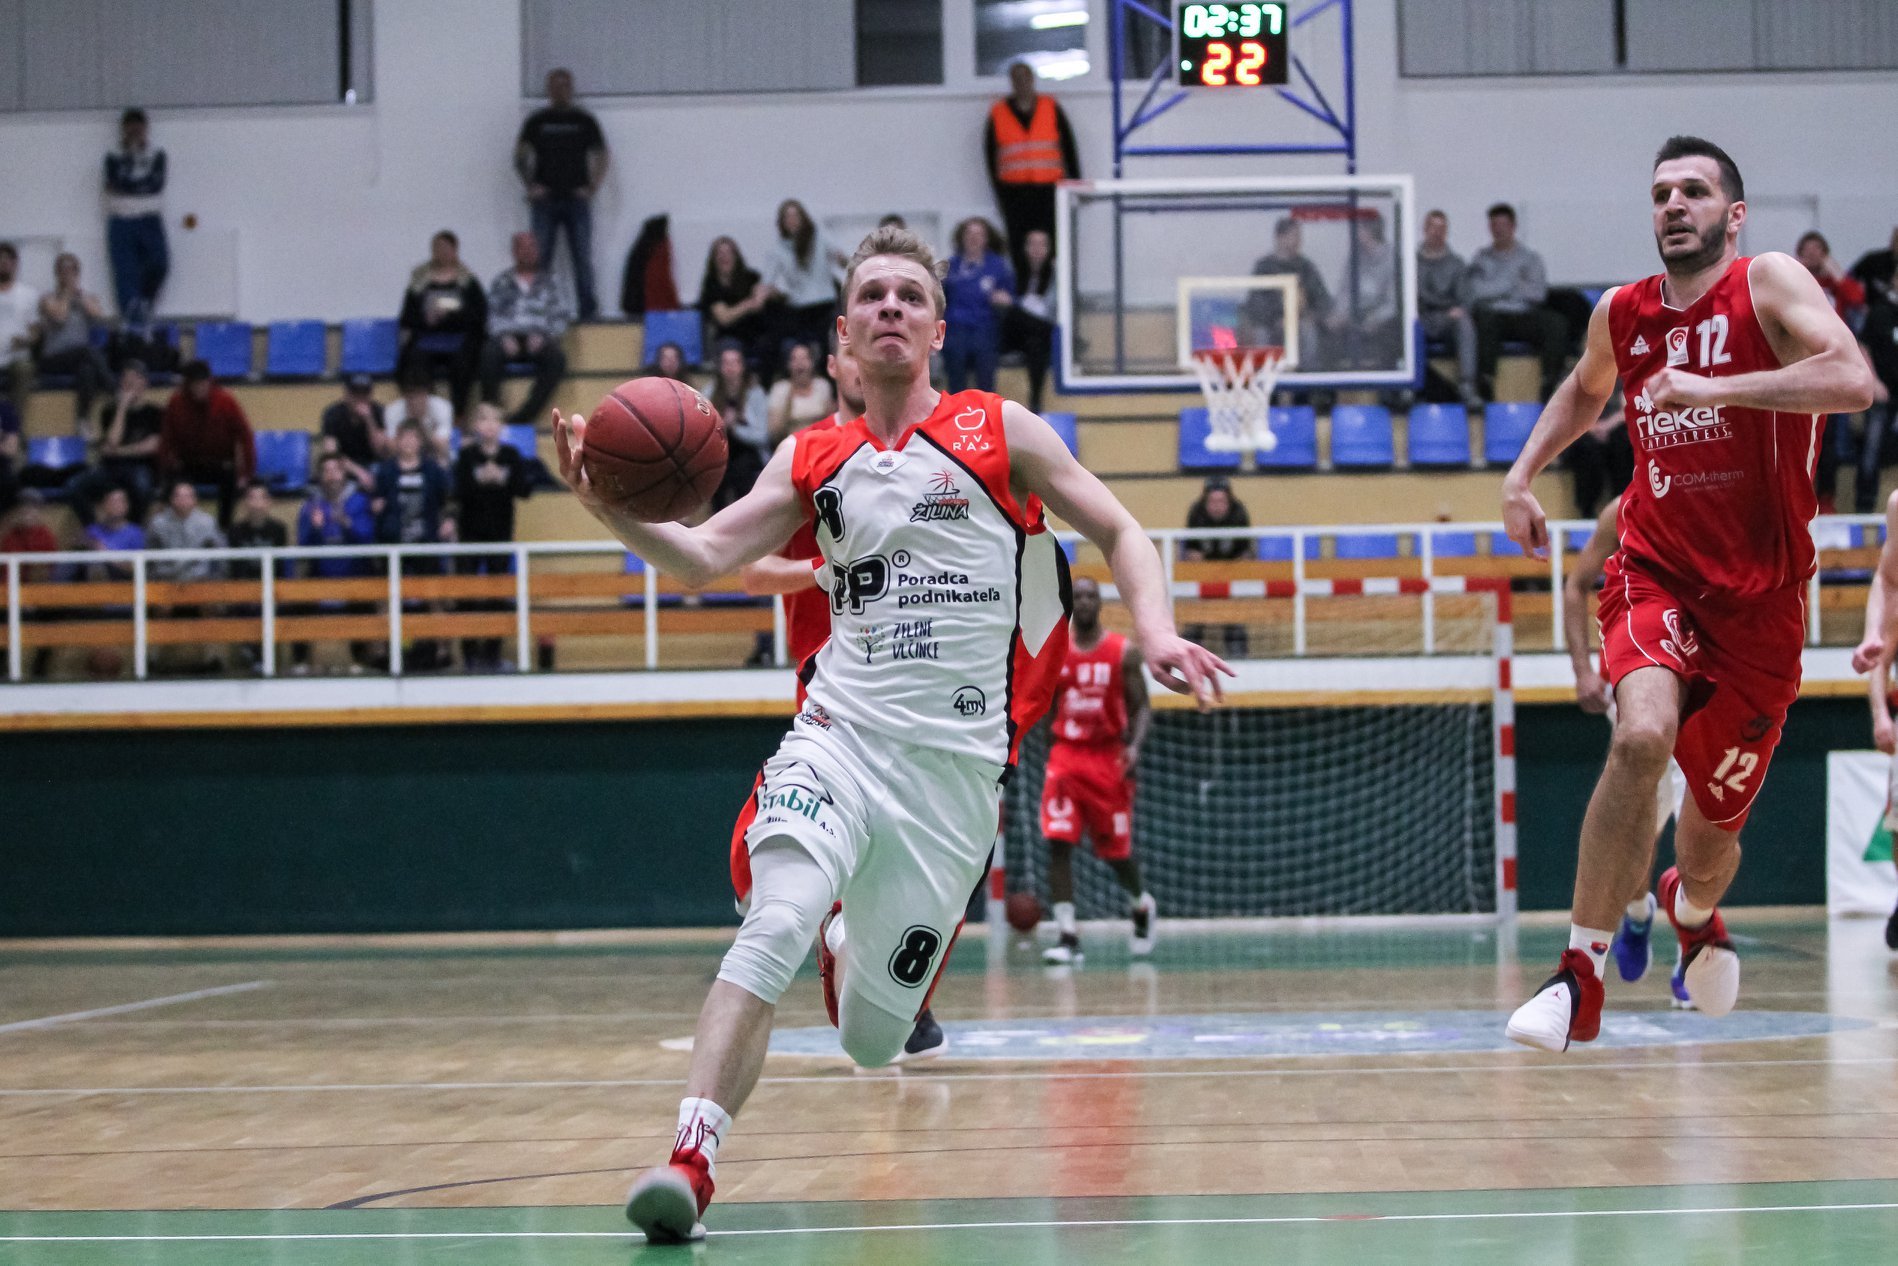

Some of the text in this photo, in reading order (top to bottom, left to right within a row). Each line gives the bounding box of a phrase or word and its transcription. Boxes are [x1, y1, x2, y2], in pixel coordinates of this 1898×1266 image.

[1184, 4, 1283, 38] 02:37
[1201, 42, 1266, 86] 22
[1696, 314, 1732, 368] 12
[952, 441, 990, 452] RAJ
[910, 502, 969, 522] ŽILINA
[898, 571, 969, 587] Poradca
[898, 587, 1001, 609] podnikateľa
[1713, 746, 1759, 793] 12
[887, 924, 943, 989] 8
